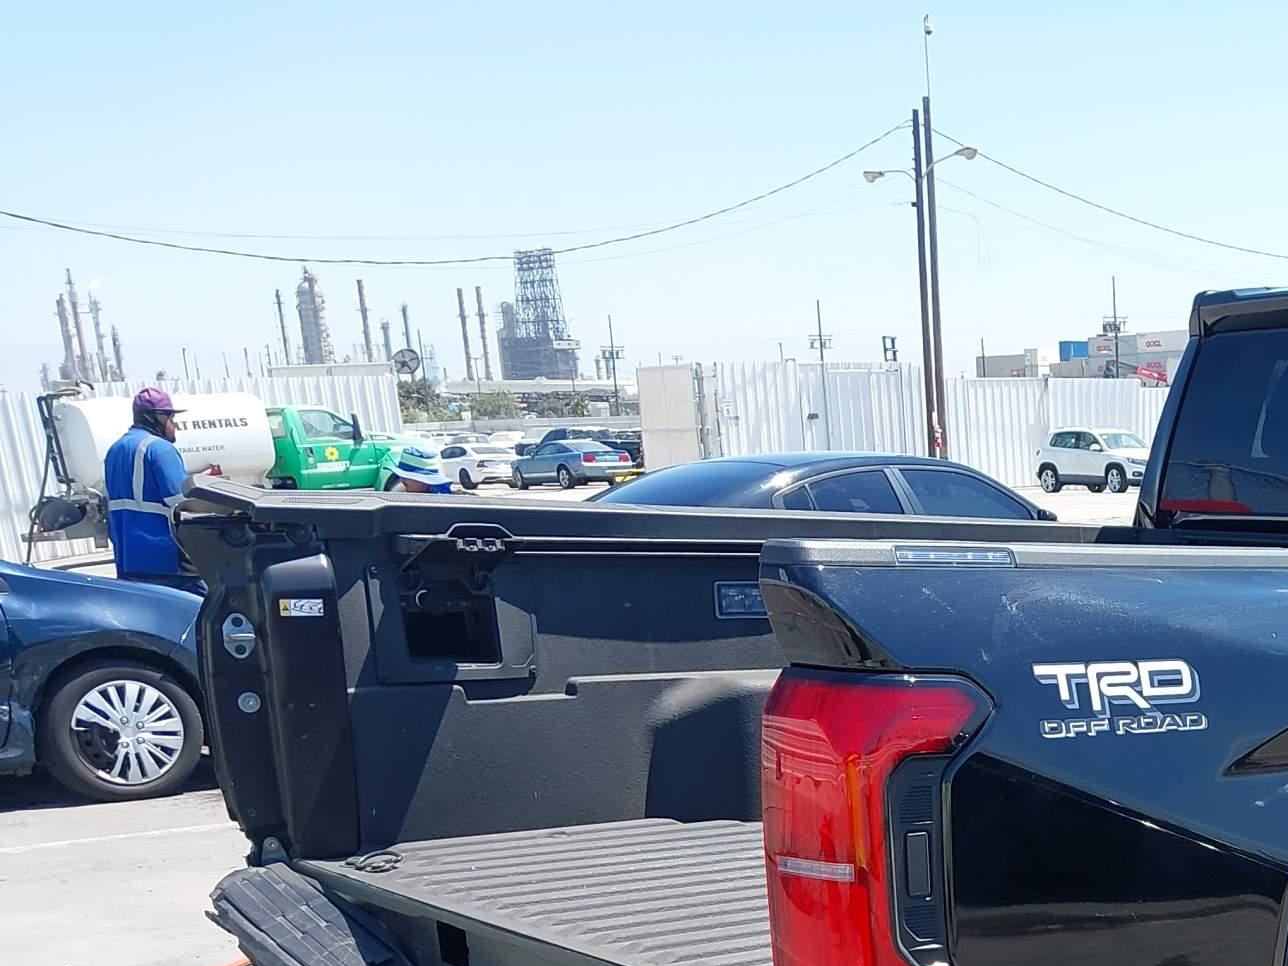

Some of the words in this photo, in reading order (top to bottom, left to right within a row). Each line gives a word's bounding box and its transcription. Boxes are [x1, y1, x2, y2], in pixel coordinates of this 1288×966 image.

[192, 417, 249, 430] RENTALS
[179, 446, 201, 454] TABLE
[202, 444, 225, 453] WATER
[1031, 659, 1201, 718] TRD
[1039, 718, 1110, 739] OFF
[1113, 712, 1208, 735] ROAD
